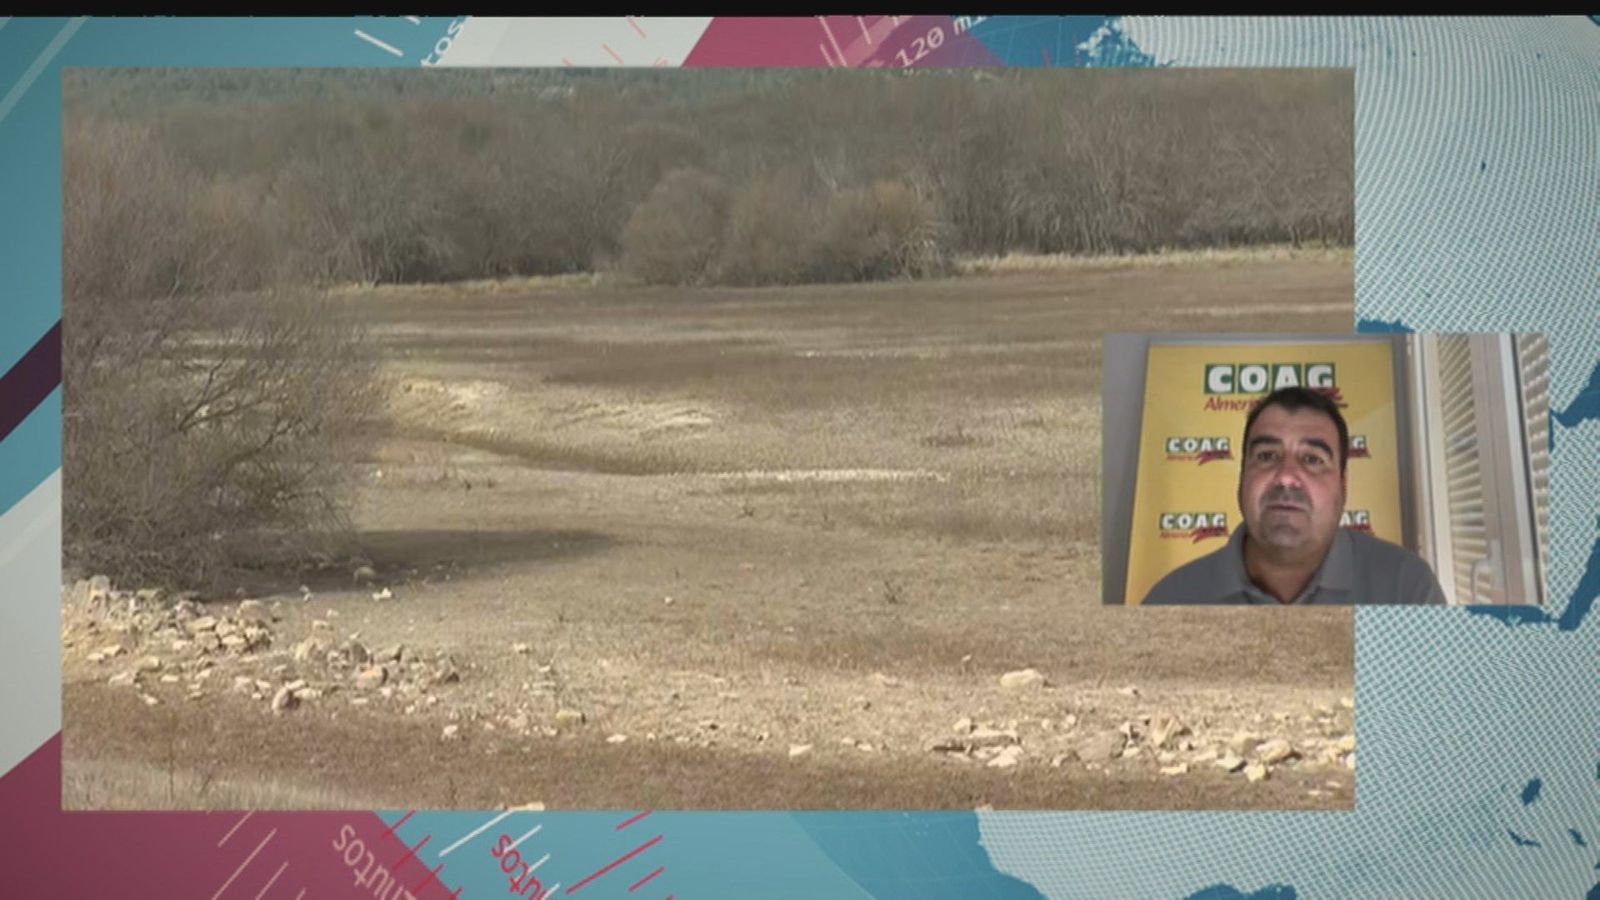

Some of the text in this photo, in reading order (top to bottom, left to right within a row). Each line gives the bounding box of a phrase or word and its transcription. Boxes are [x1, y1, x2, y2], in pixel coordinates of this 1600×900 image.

[894, 26, 945, 67] 120
[1207, 364, 1334, 391] COAG
[1168, 437, 1228, 451] COAG
[1162, 512, 1225, 529] COAG
